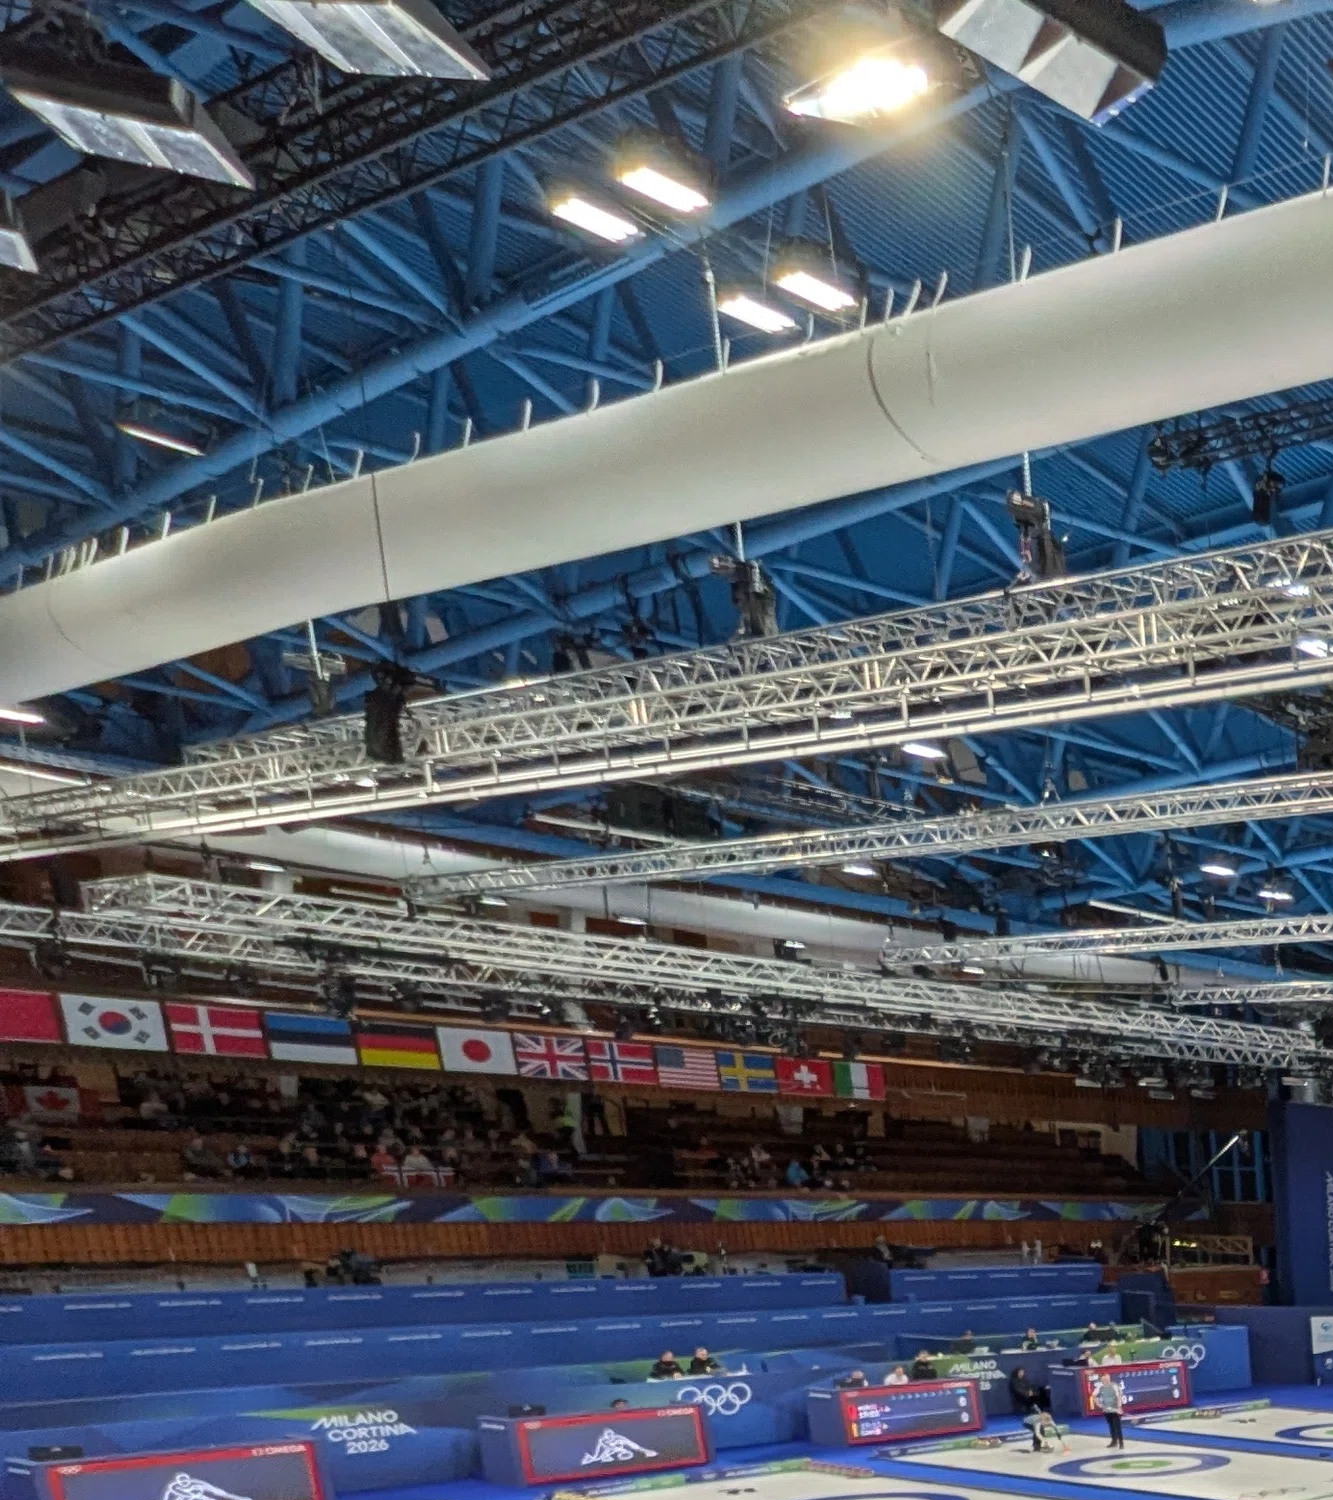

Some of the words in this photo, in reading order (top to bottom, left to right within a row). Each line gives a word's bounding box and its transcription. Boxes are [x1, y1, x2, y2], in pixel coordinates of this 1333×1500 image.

[311, 1409, 399, 1431] MILANO
[327, 1422, 418, 1442] CORTINA
[346, 1439, 390, 1455] 2026
